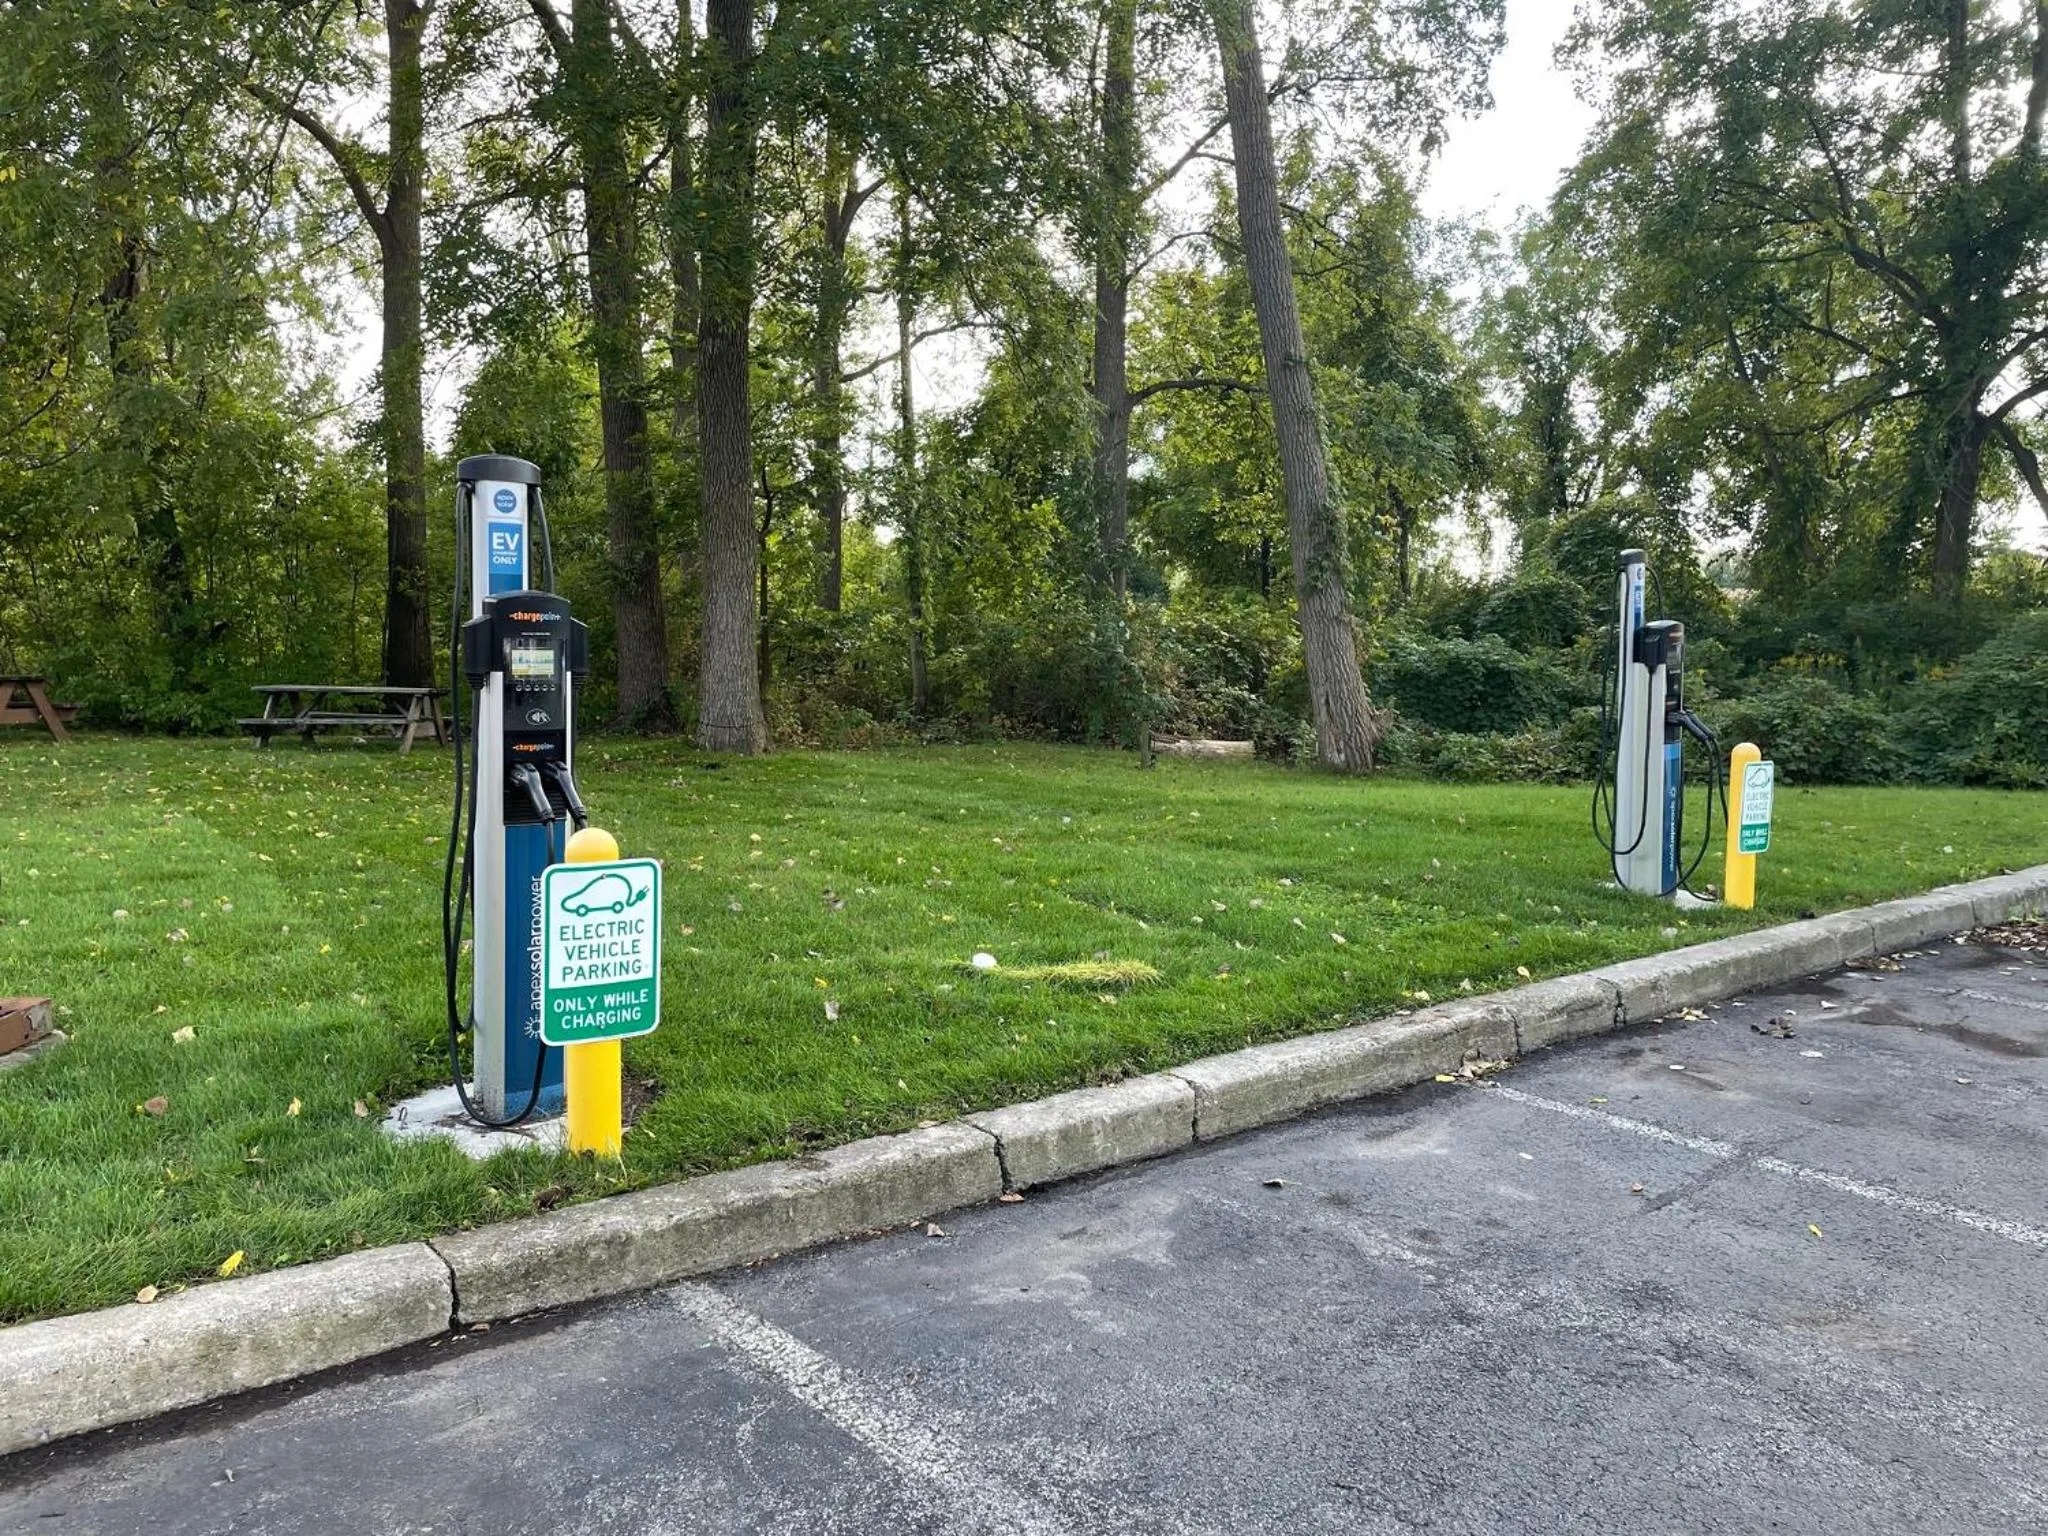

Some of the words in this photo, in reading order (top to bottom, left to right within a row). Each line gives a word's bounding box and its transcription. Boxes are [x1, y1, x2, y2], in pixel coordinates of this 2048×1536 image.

[492, 532, 519, 550] EV
[492, 557, 517, 566] ONLY
[560, 918, 645, 942] ELECTRIC
[565, 939, 641, 961] VEHICLE
[562, 960, 642, 983] PARKING
[553, 996, 598, 1013] ONLY
[603, 989, 649, 1008] WHILE
[561, 1007, 642, 1029] CHARGING
